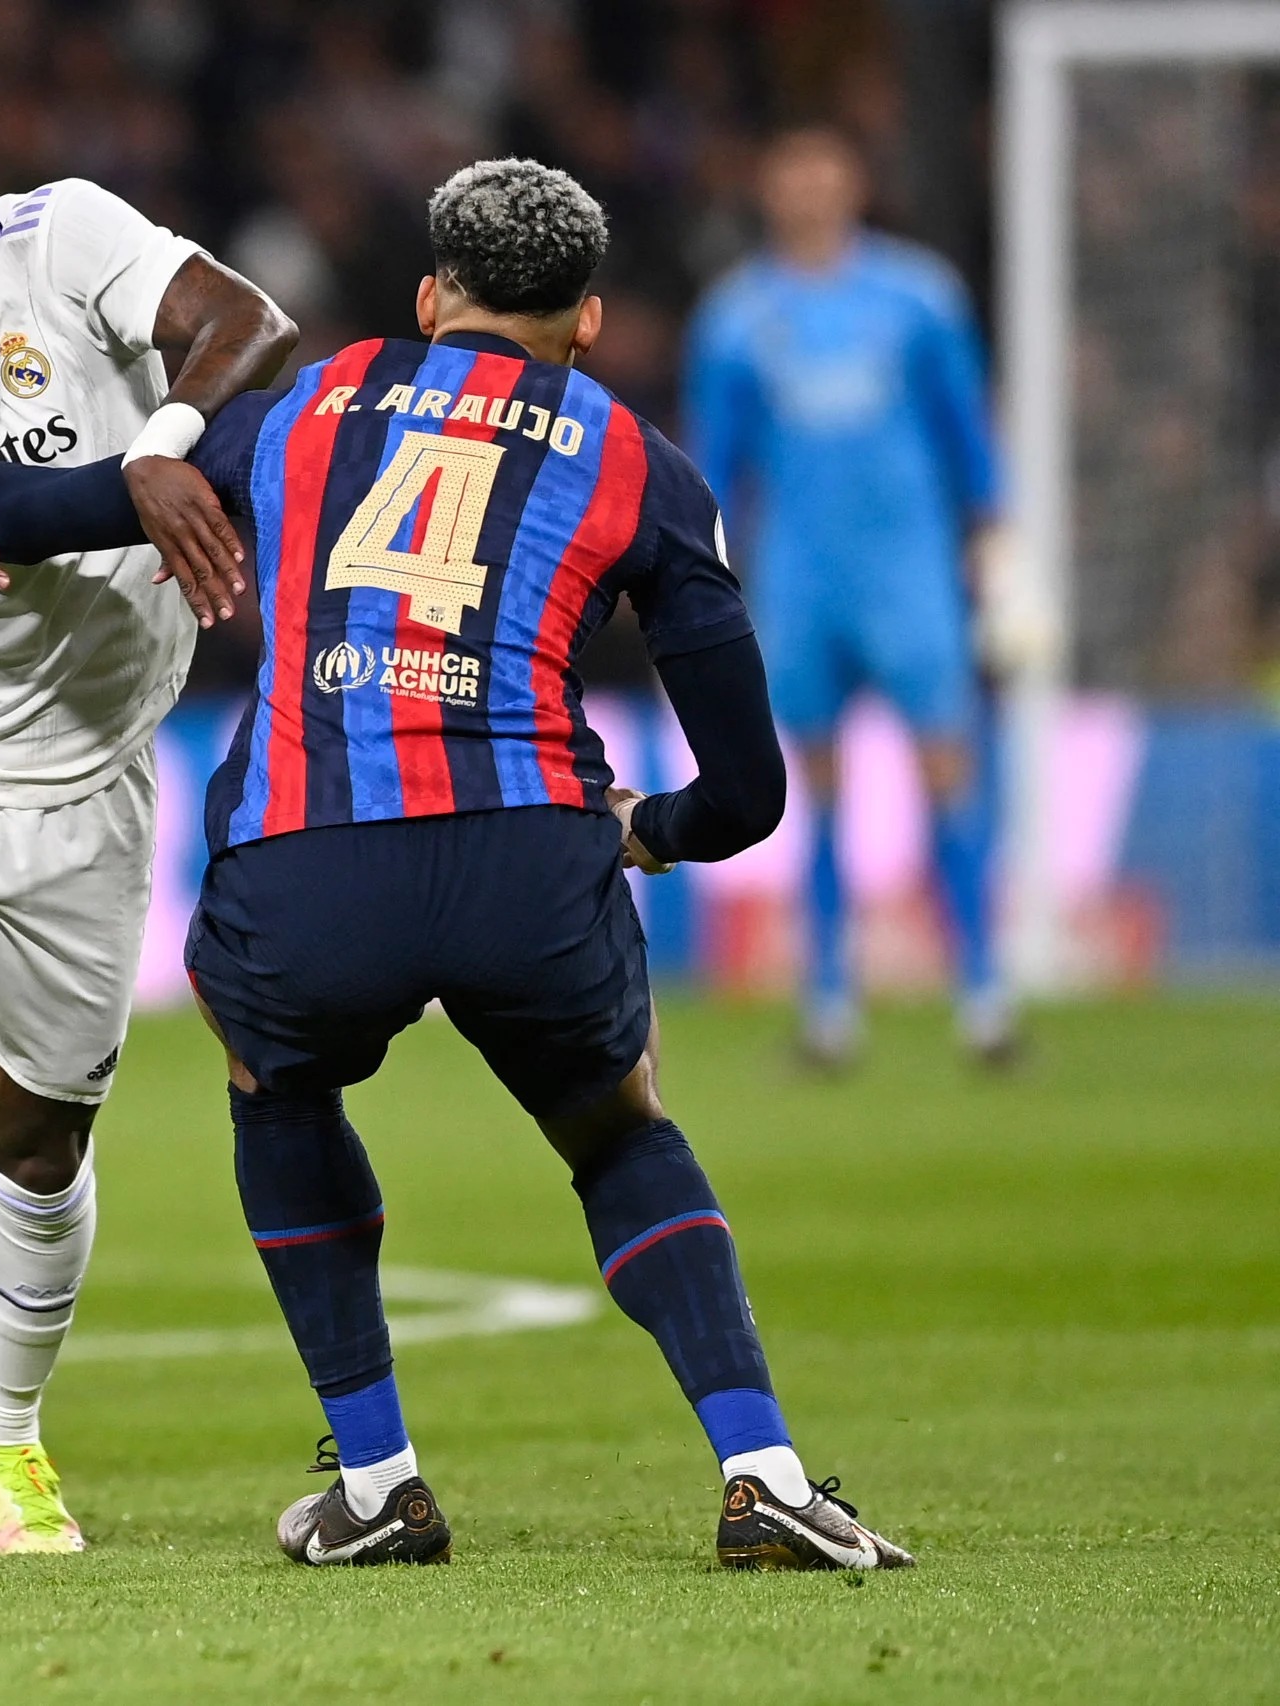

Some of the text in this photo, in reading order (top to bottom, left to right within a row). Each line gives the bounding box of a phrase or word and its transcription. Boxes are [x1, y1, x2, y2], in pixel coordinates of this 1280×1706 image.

[313, 383, 585, 457] R. ARAUJO
[324, 430, 508, 637] 4
[381, 646, 481, 676] UNHCR
[378, 666, 479, 698] ACNUR
[379, 686, 477, 708] The UN Refugee Agency
